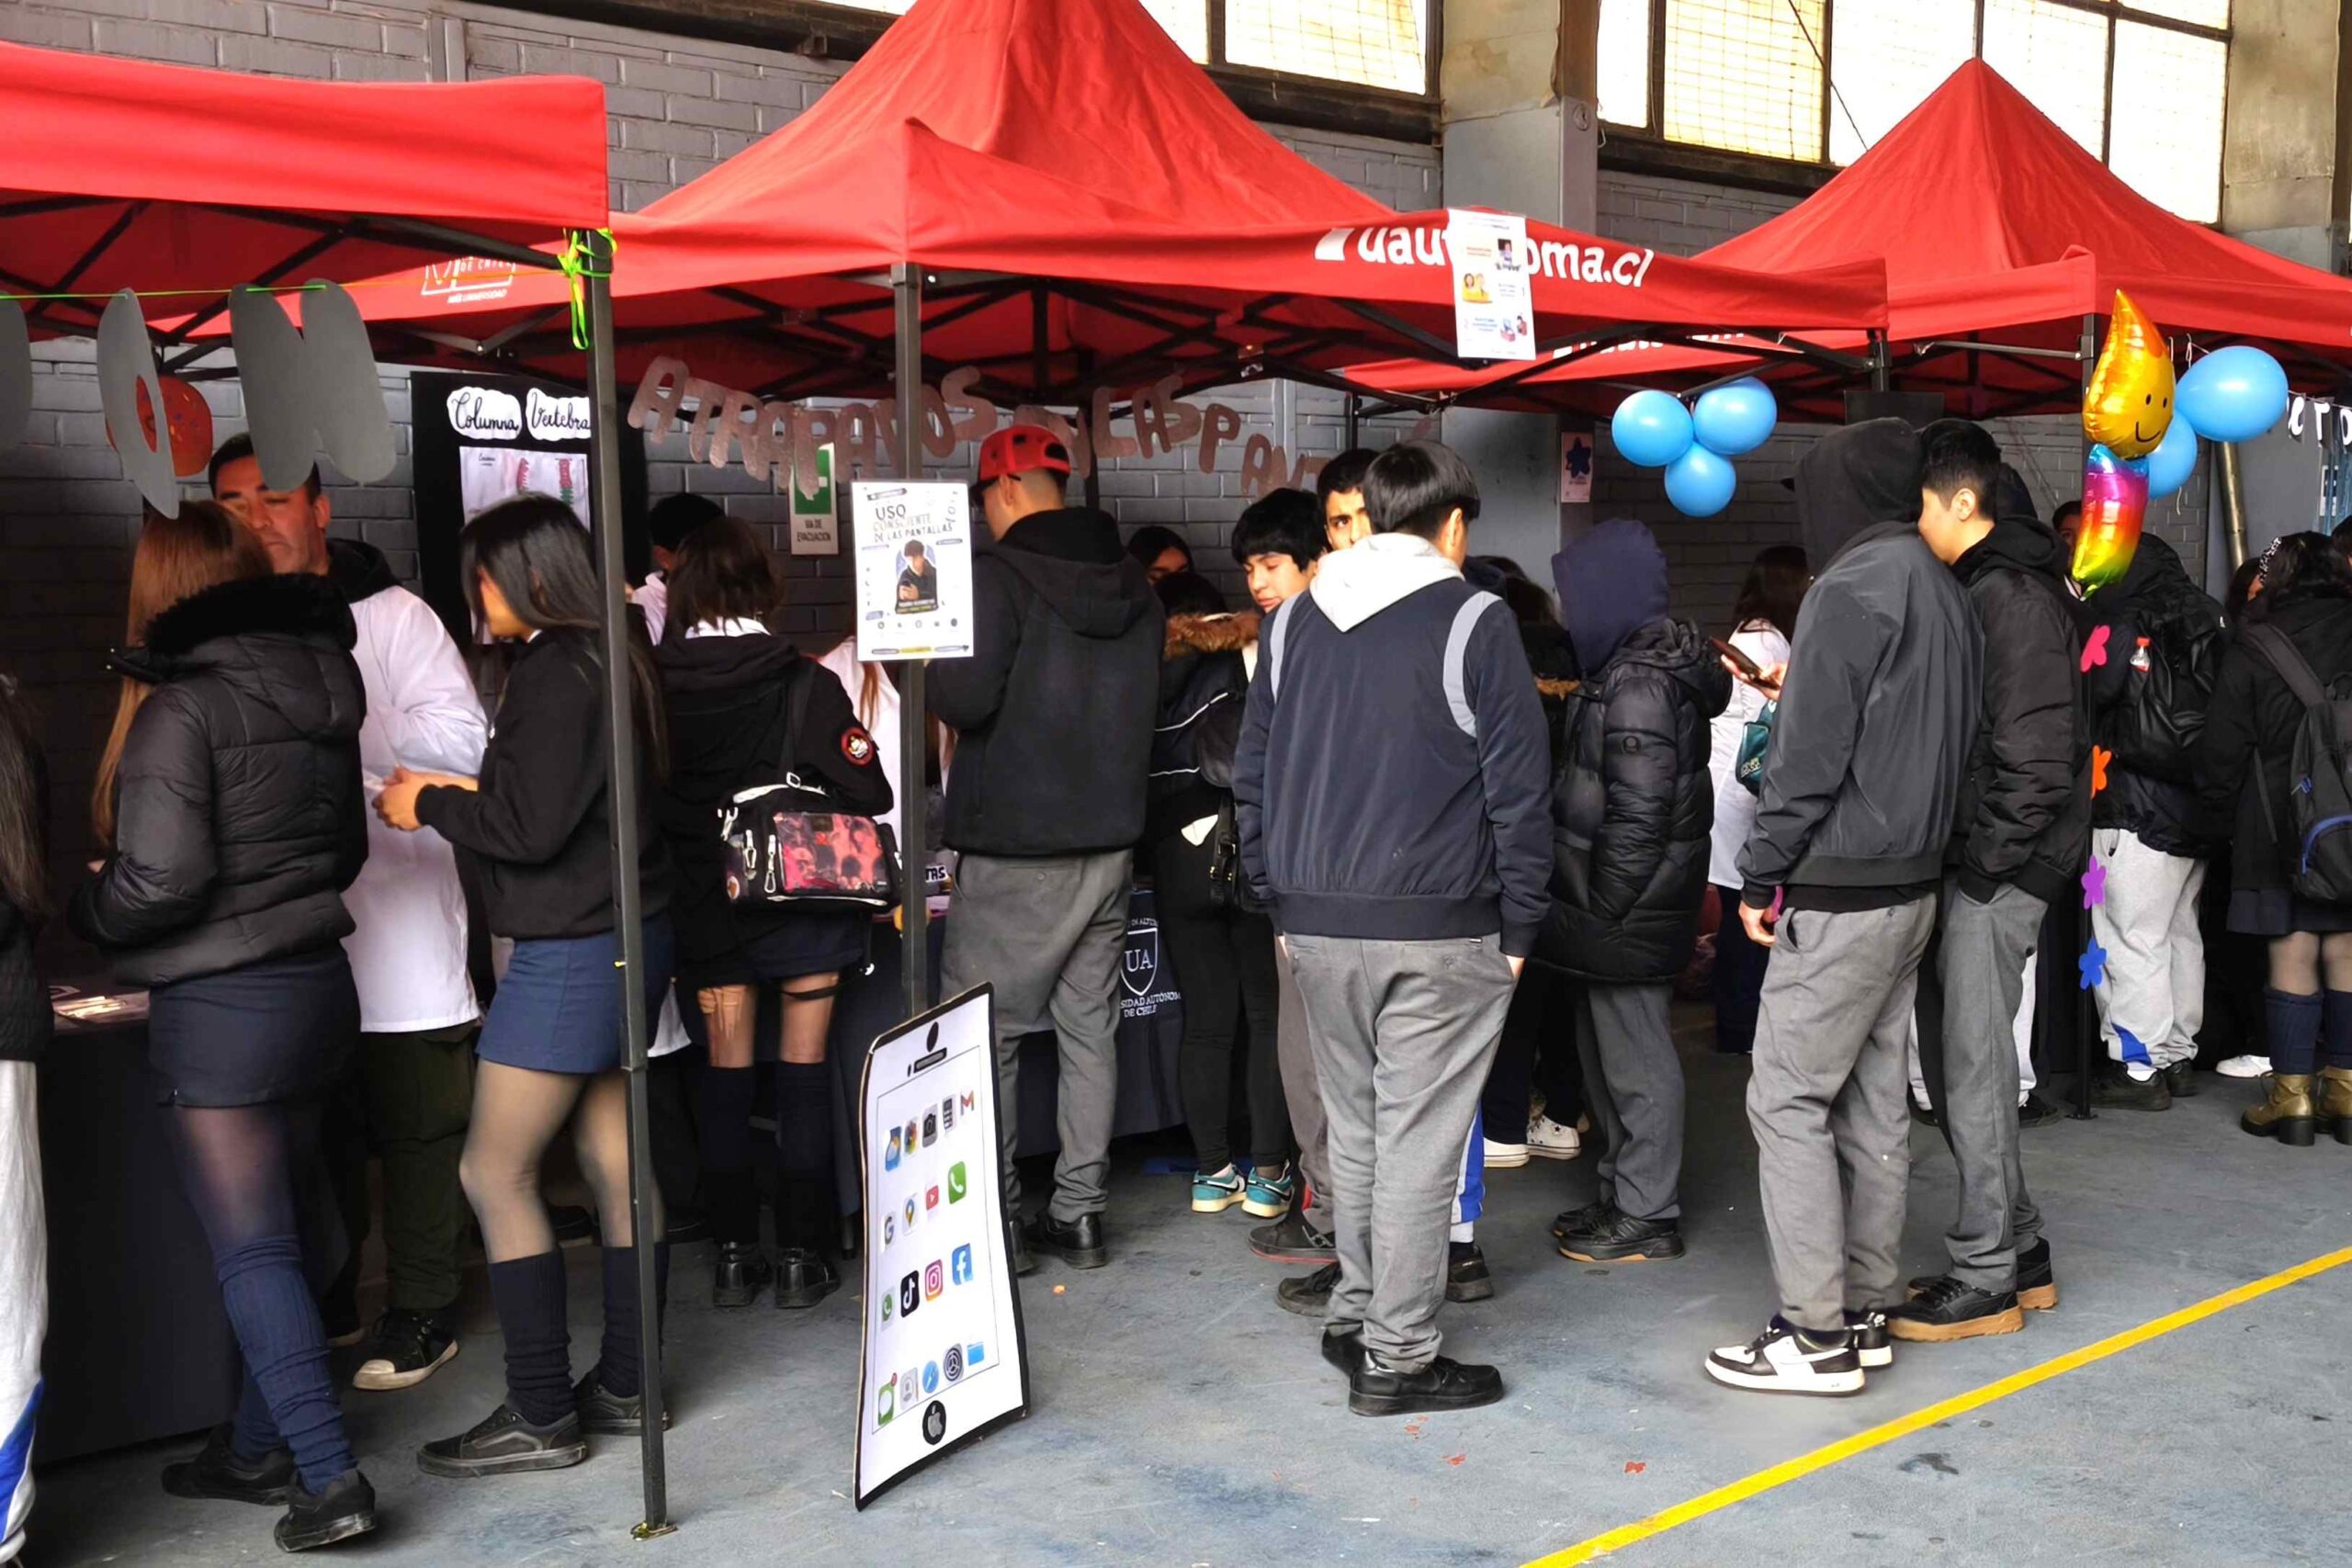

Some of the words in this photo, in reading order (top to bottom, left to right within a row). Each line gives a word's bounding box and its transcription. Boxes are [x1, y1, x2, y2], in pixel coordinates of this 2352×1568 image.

[1357, 226, 1654, 288] uauoma.cl
[451, 391, 519, 431] Columna
[530, 391, 591, 431] Vertebra
[888, 530, 903, 541] LAS
[905, 522, 953, 537] PANTALLAS
[1125, 949, 1154, 973] UA
[1120, 998, 1146, 1010] SIDAD
[1124, 1008, 1136, 1018] DE
